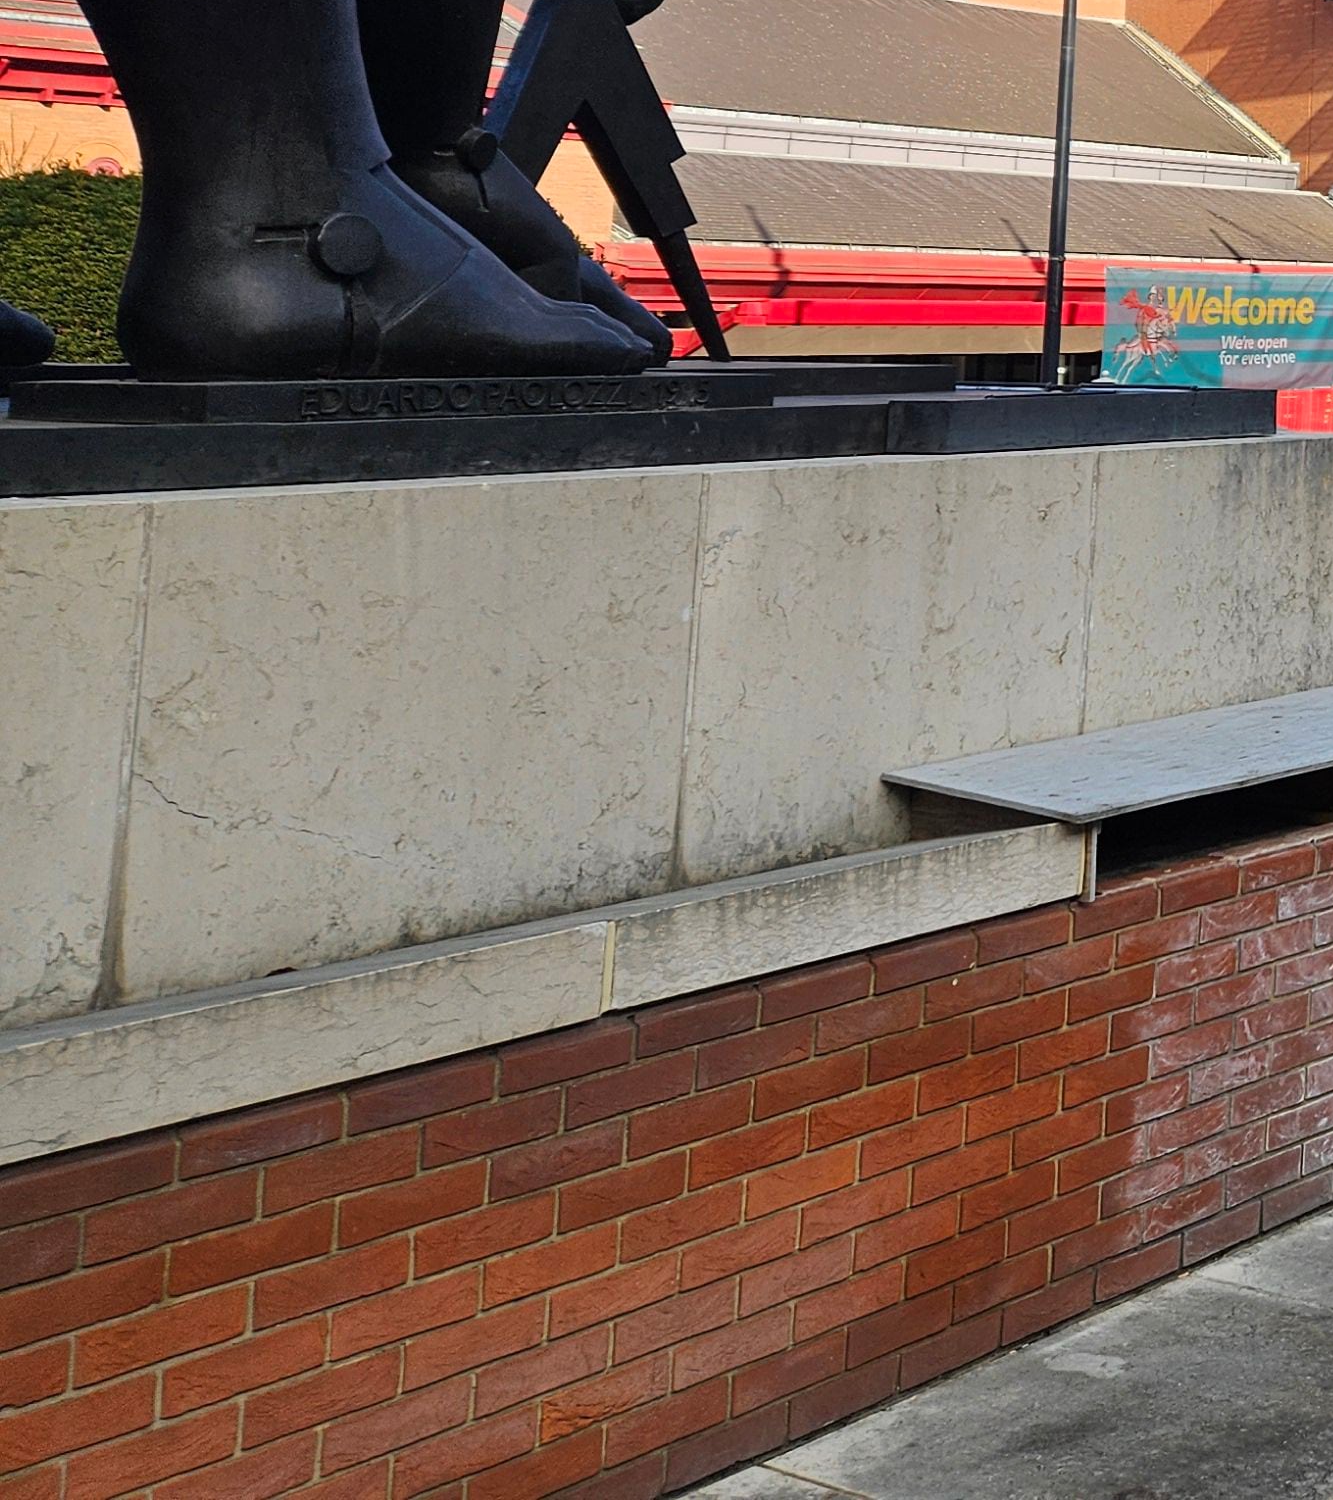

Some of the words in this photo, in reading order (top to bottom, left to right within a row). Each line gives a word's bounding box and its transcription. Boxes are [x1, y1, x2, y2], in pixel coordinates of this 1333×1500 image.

[1167, 285, 1315, 326] Welcome
[1221, 336, 1254, 349] We're
[1257, 337, 1287, 352] open
[1219, 351, 1240, 365] for
[1241, 353, 1296, 368] everyone
[302, 382, 477, 416] EDUARDO
